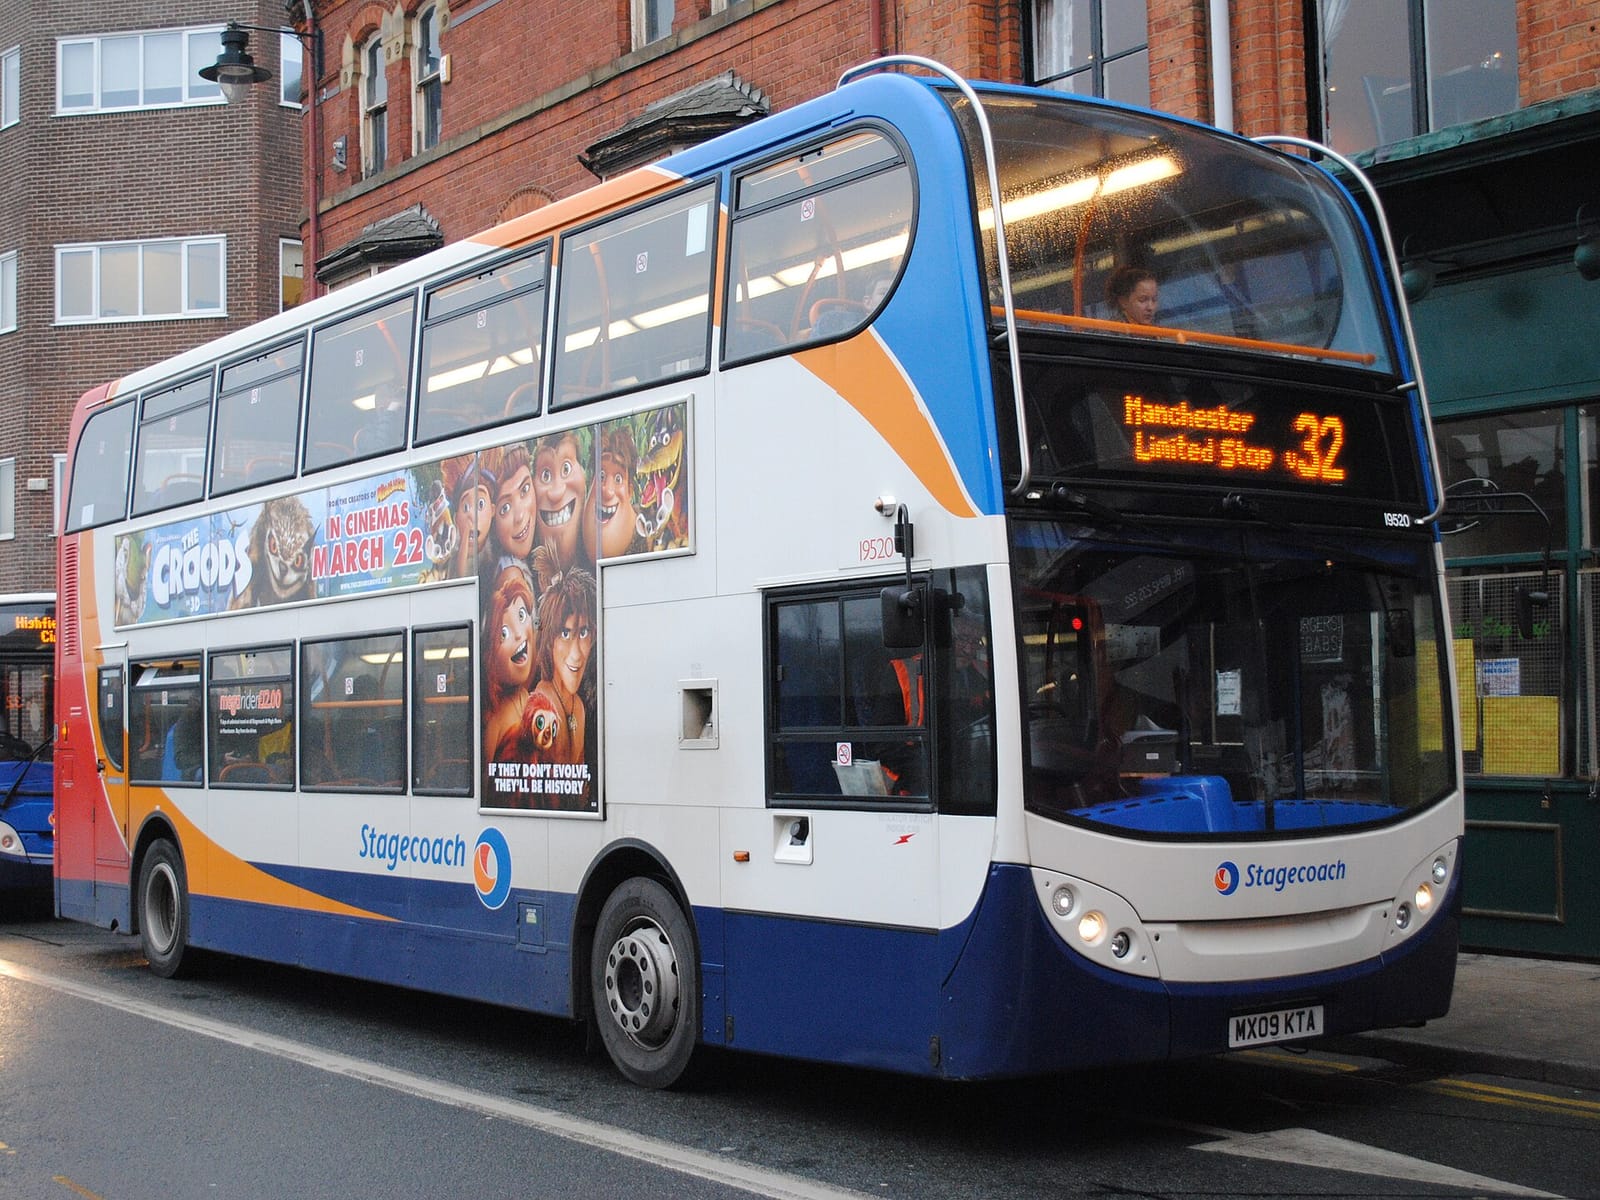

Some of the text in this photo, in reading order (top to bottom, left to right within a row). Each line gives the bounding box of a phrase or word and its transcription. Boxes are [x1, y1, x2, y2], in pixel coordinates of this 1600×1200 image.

[1124, 396, 1254, 432] Manchester
[1135, 431, 1275, 470] Limited Stop
[345, 501, 410, 537] CINEMAS
[1384, 512, 1410, 527] 19520
[182, 527, 200, 551] THE
[312, 528, 424, 580] MARCH 22
[859, 537, 894, 561] 19520
[152, 529, 252, 606] CROODS
[15, 616, 57, 629] Highfie
[488, 763, 591, 781] IF THEY DON'T EVOLVE,
[494, 779, 584, 794] THEY'LL BE HISTORY
[359, 823, 466, 871] Stagecoach
[1245, 859, 1346, 892] Stagecoach
[1235, 1009, 1315, 1042] MX09 KTA
